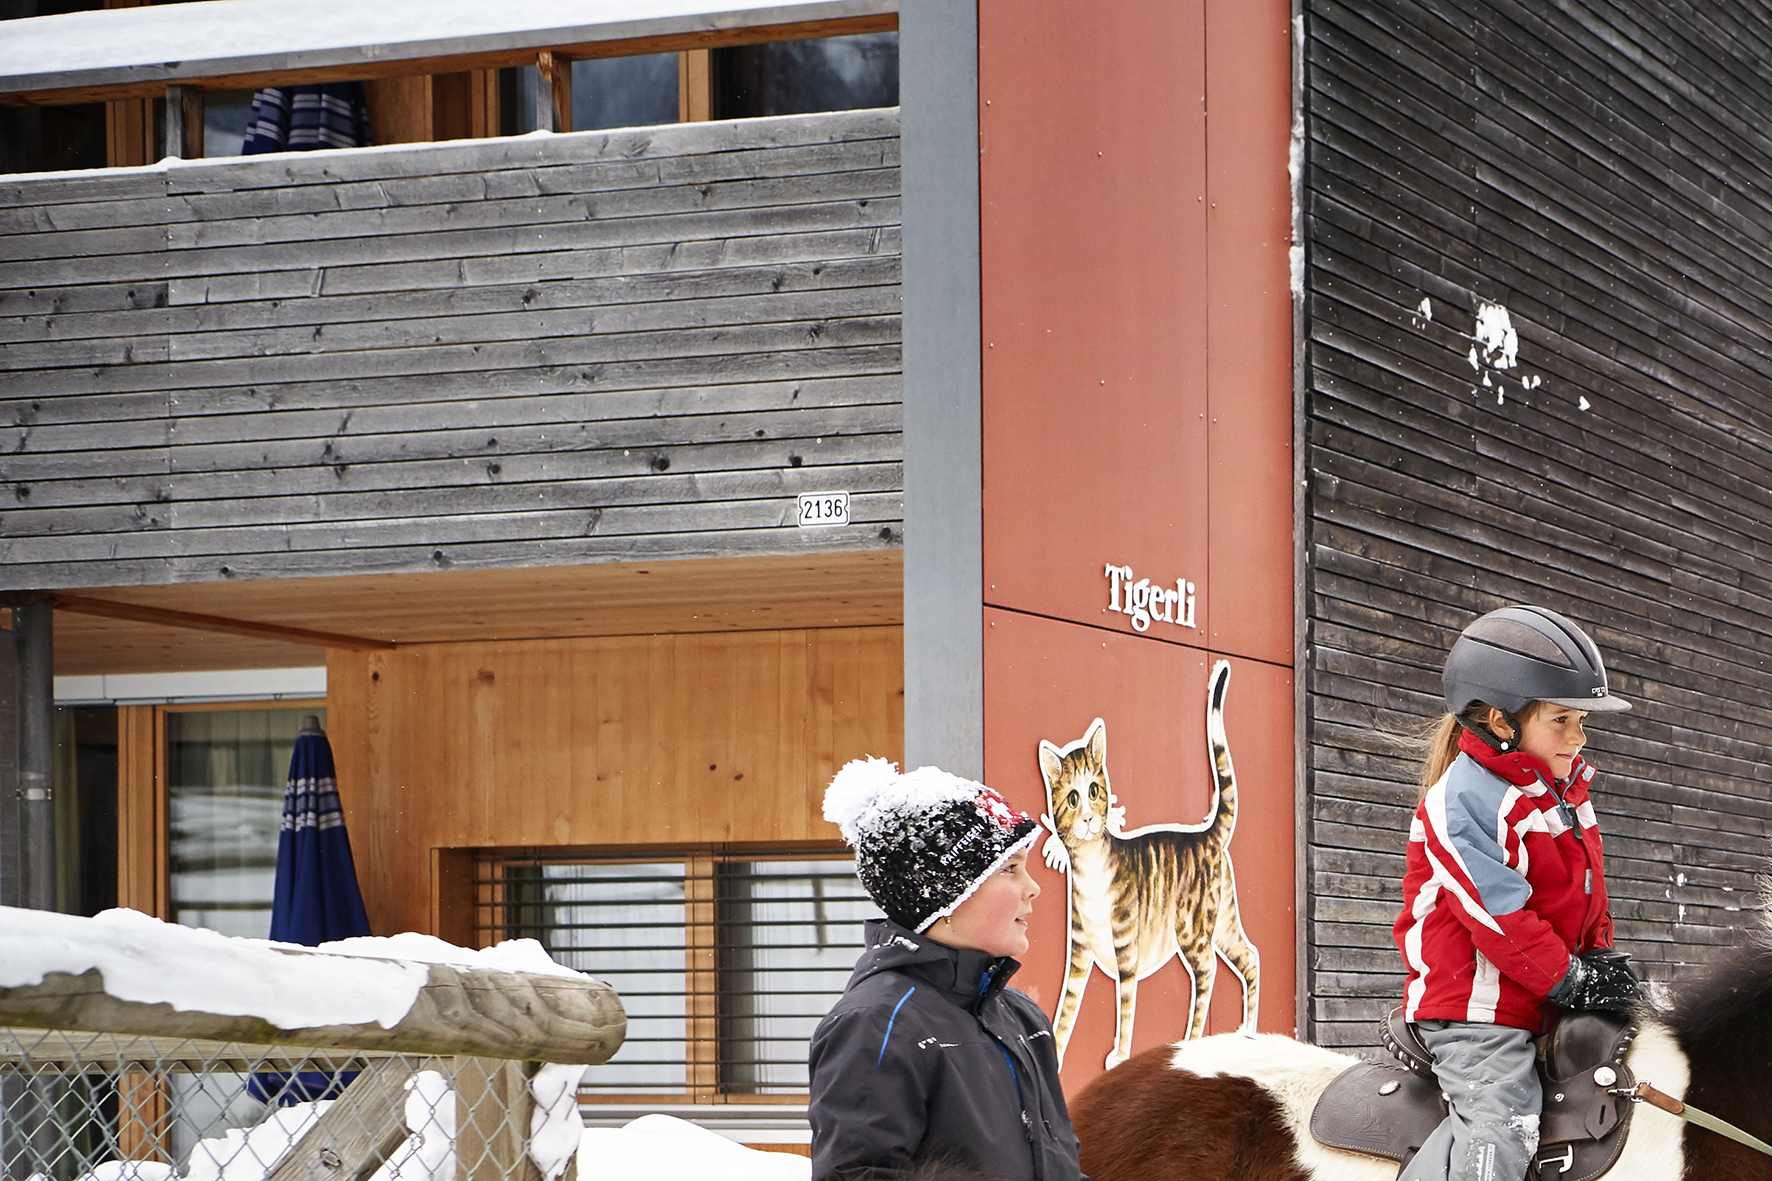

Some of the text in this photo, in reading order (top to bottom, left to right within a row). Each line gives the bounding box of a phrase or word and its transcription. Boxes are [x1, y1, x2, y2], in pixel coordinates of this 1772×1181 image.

[804, 499, 843, 518] 2136
[1104, 563, 1196, 632] Tigerli
[939, 823, 985, 866] RAIFFEISEN
